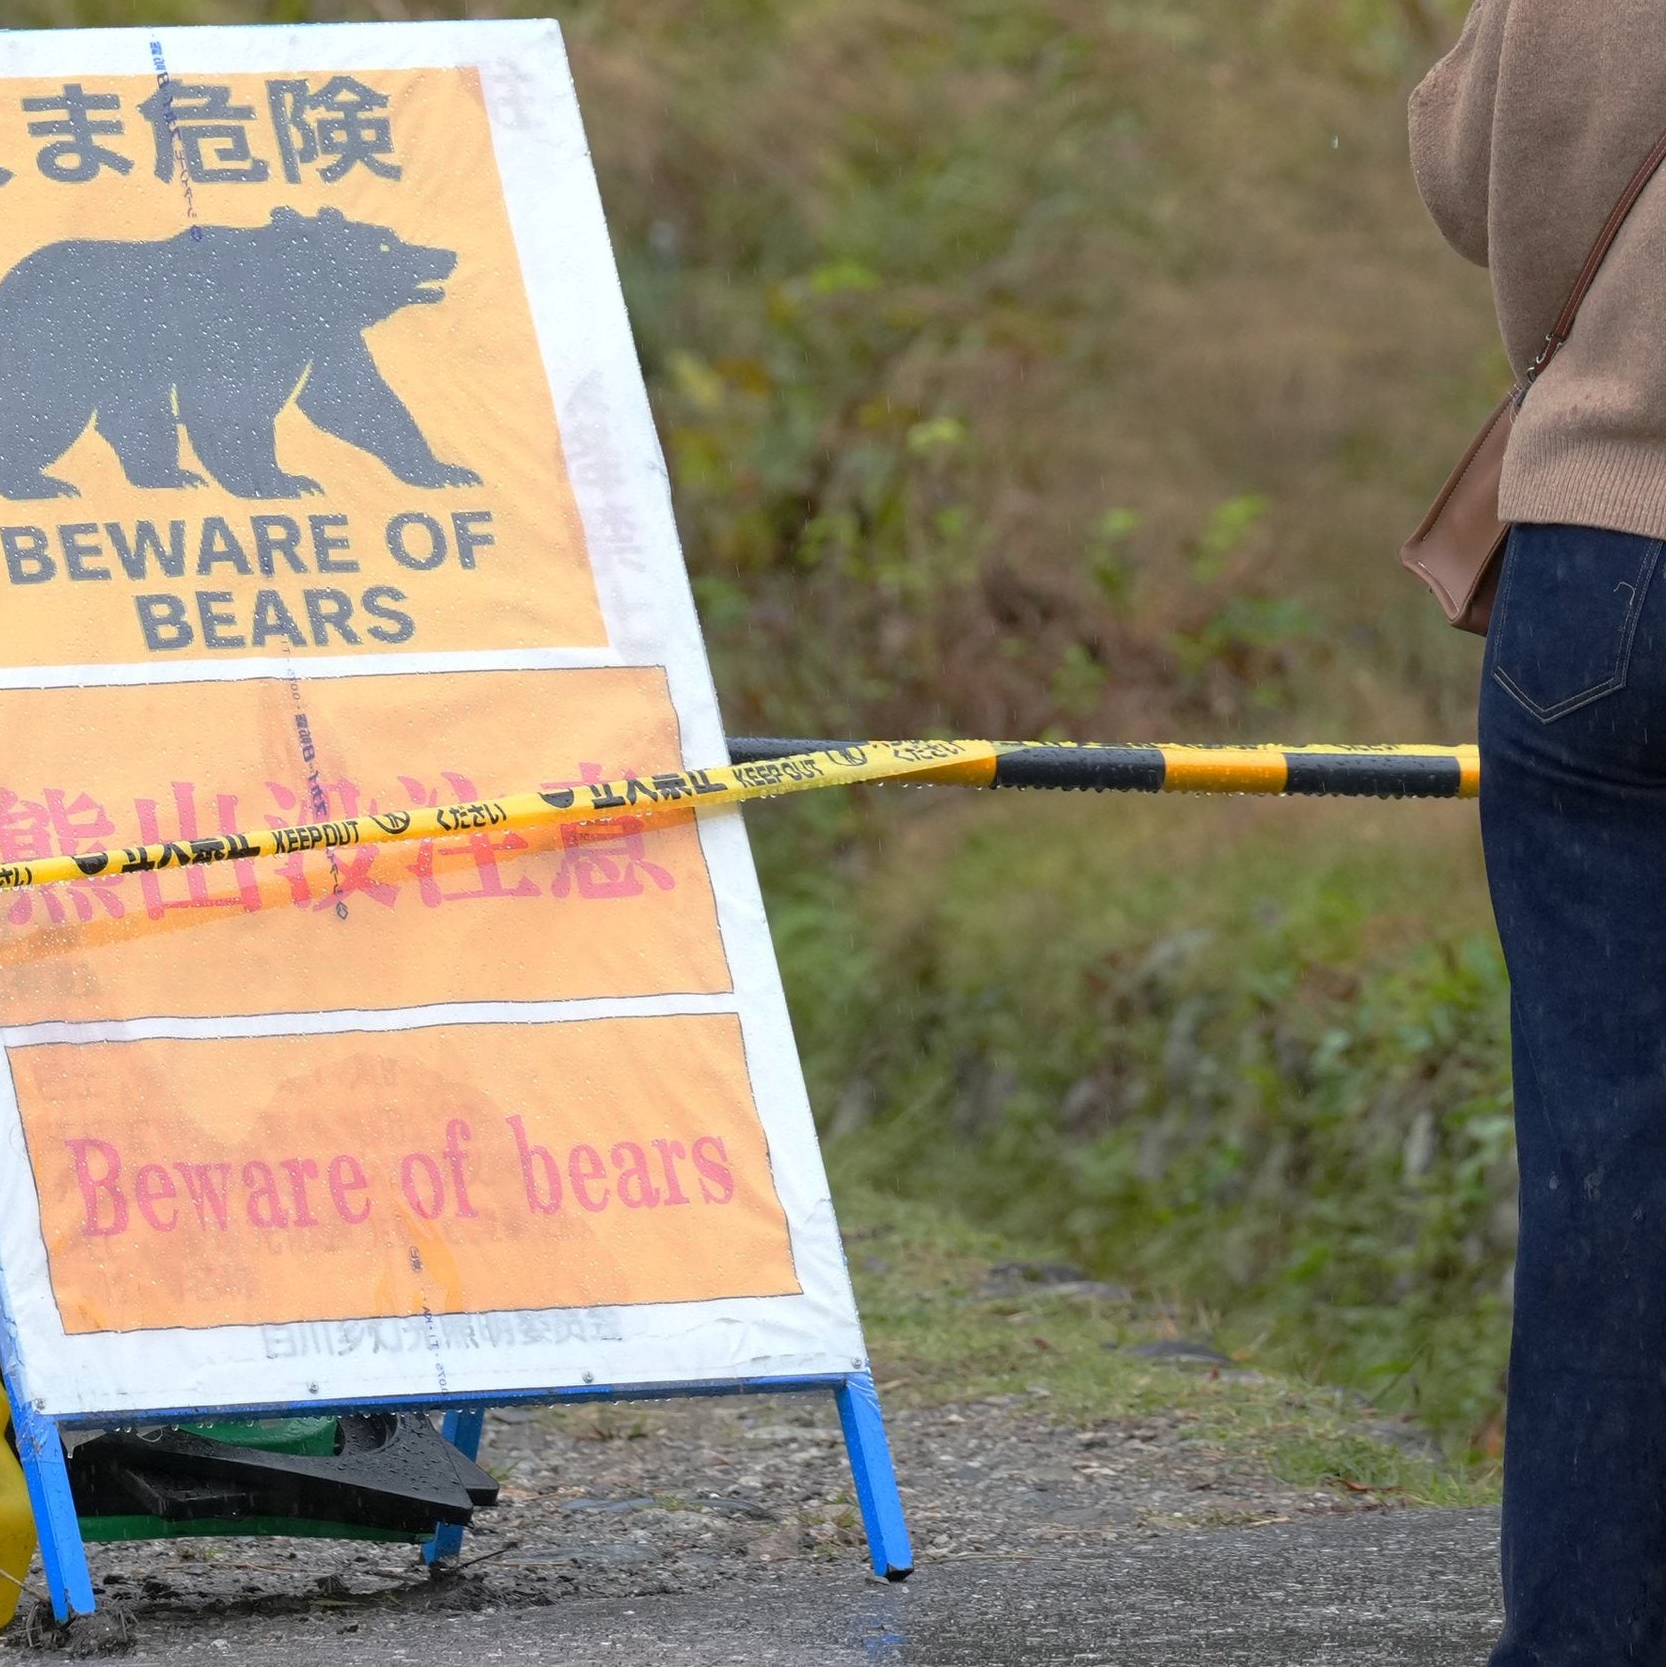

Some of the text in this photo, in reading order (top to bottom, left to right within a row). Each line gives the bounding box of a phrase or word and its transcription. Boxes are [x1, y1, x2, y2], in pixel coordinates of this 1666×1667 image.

[386, 508, 497, 573] OF
[134, 584, 417, 653] BEARS
[733, 758, 825, 789] KEEP OUT
[273, 820, 360, 854] KEEP OUT
[436, 803, 508, 832] ください
[64, 1113, 735, 1240] Beware of bears
